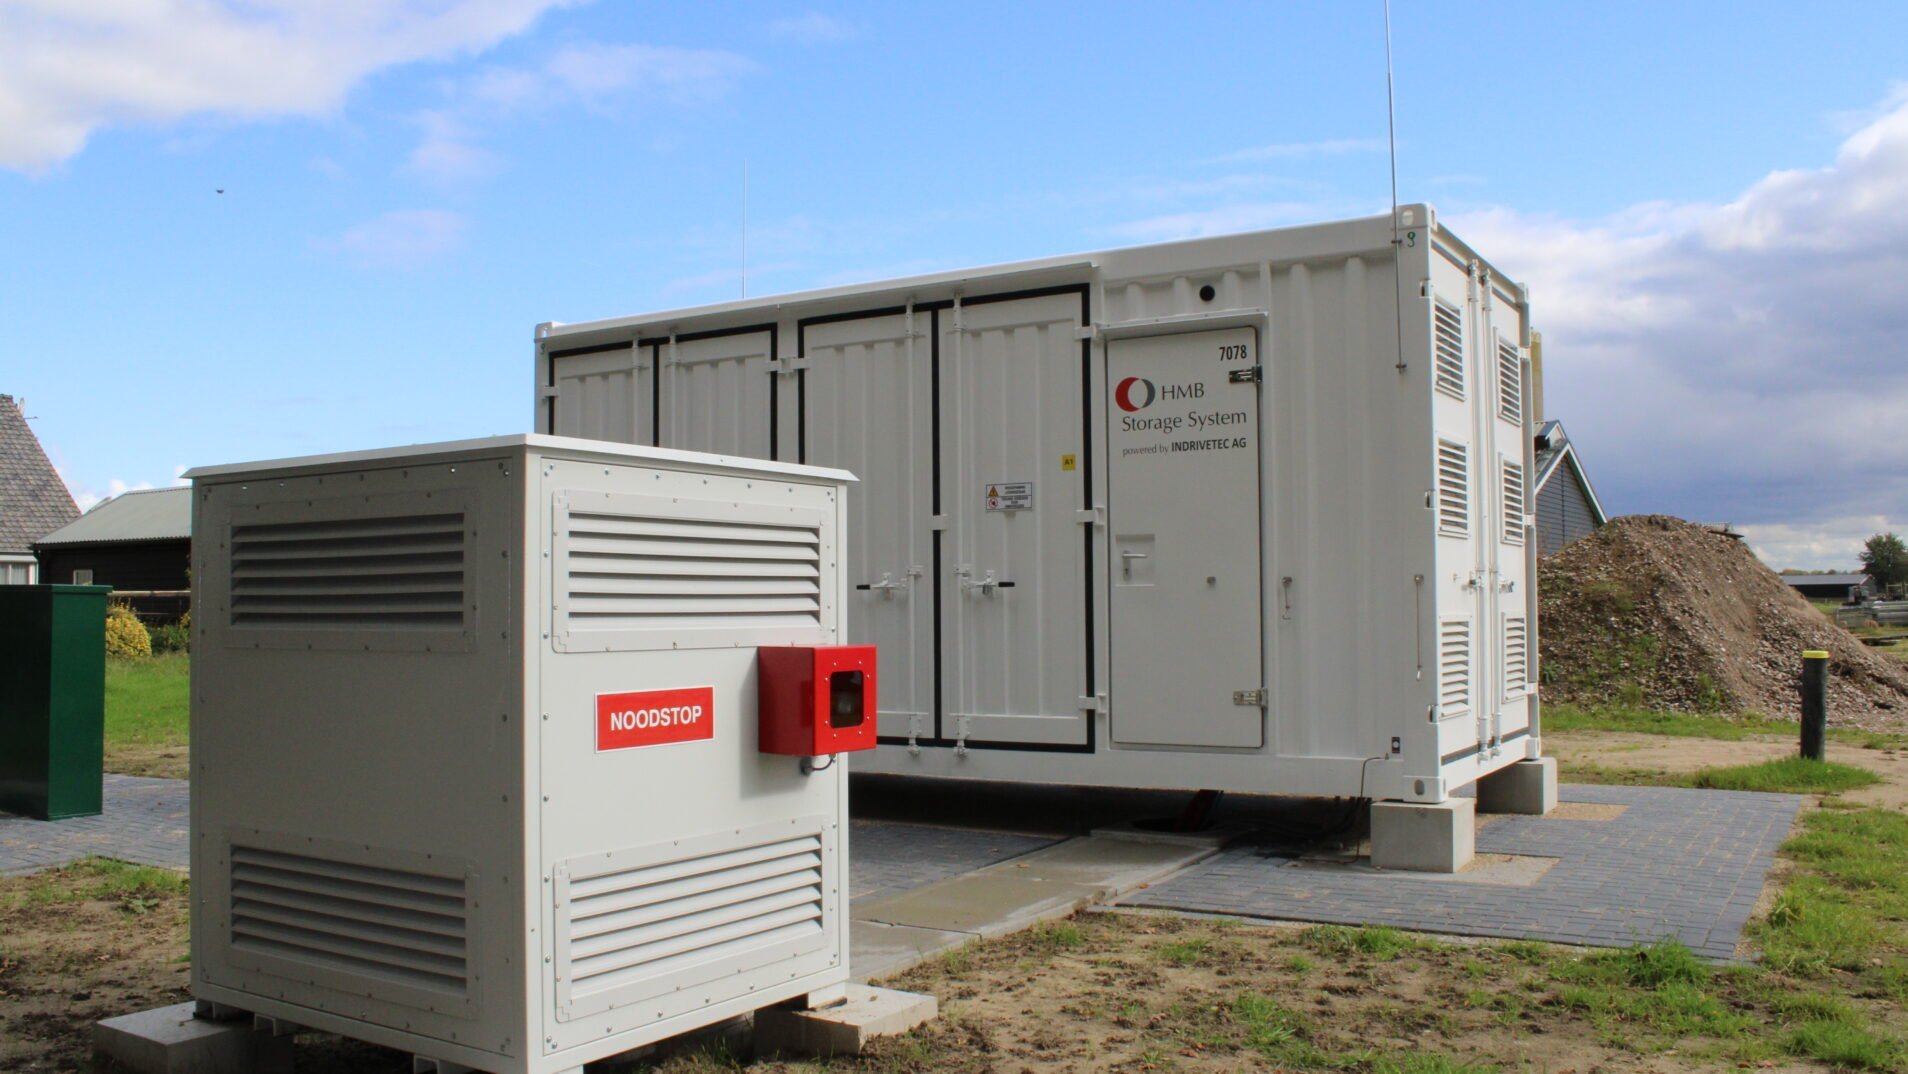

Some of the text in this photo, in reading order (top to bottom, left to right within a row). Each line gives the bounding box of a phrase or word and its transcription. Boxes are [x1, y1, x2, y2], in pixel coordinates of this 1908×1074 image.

[1219, 345, 1247, 361] 7078
[1161, 382, 1205, 400] HMB
[1122, 411, 1247, 434] Storage System
[1122, 437, 1247, 457] powered by INDRIVETEC AG
[610, 705, 702, 731] NOODSTOP
